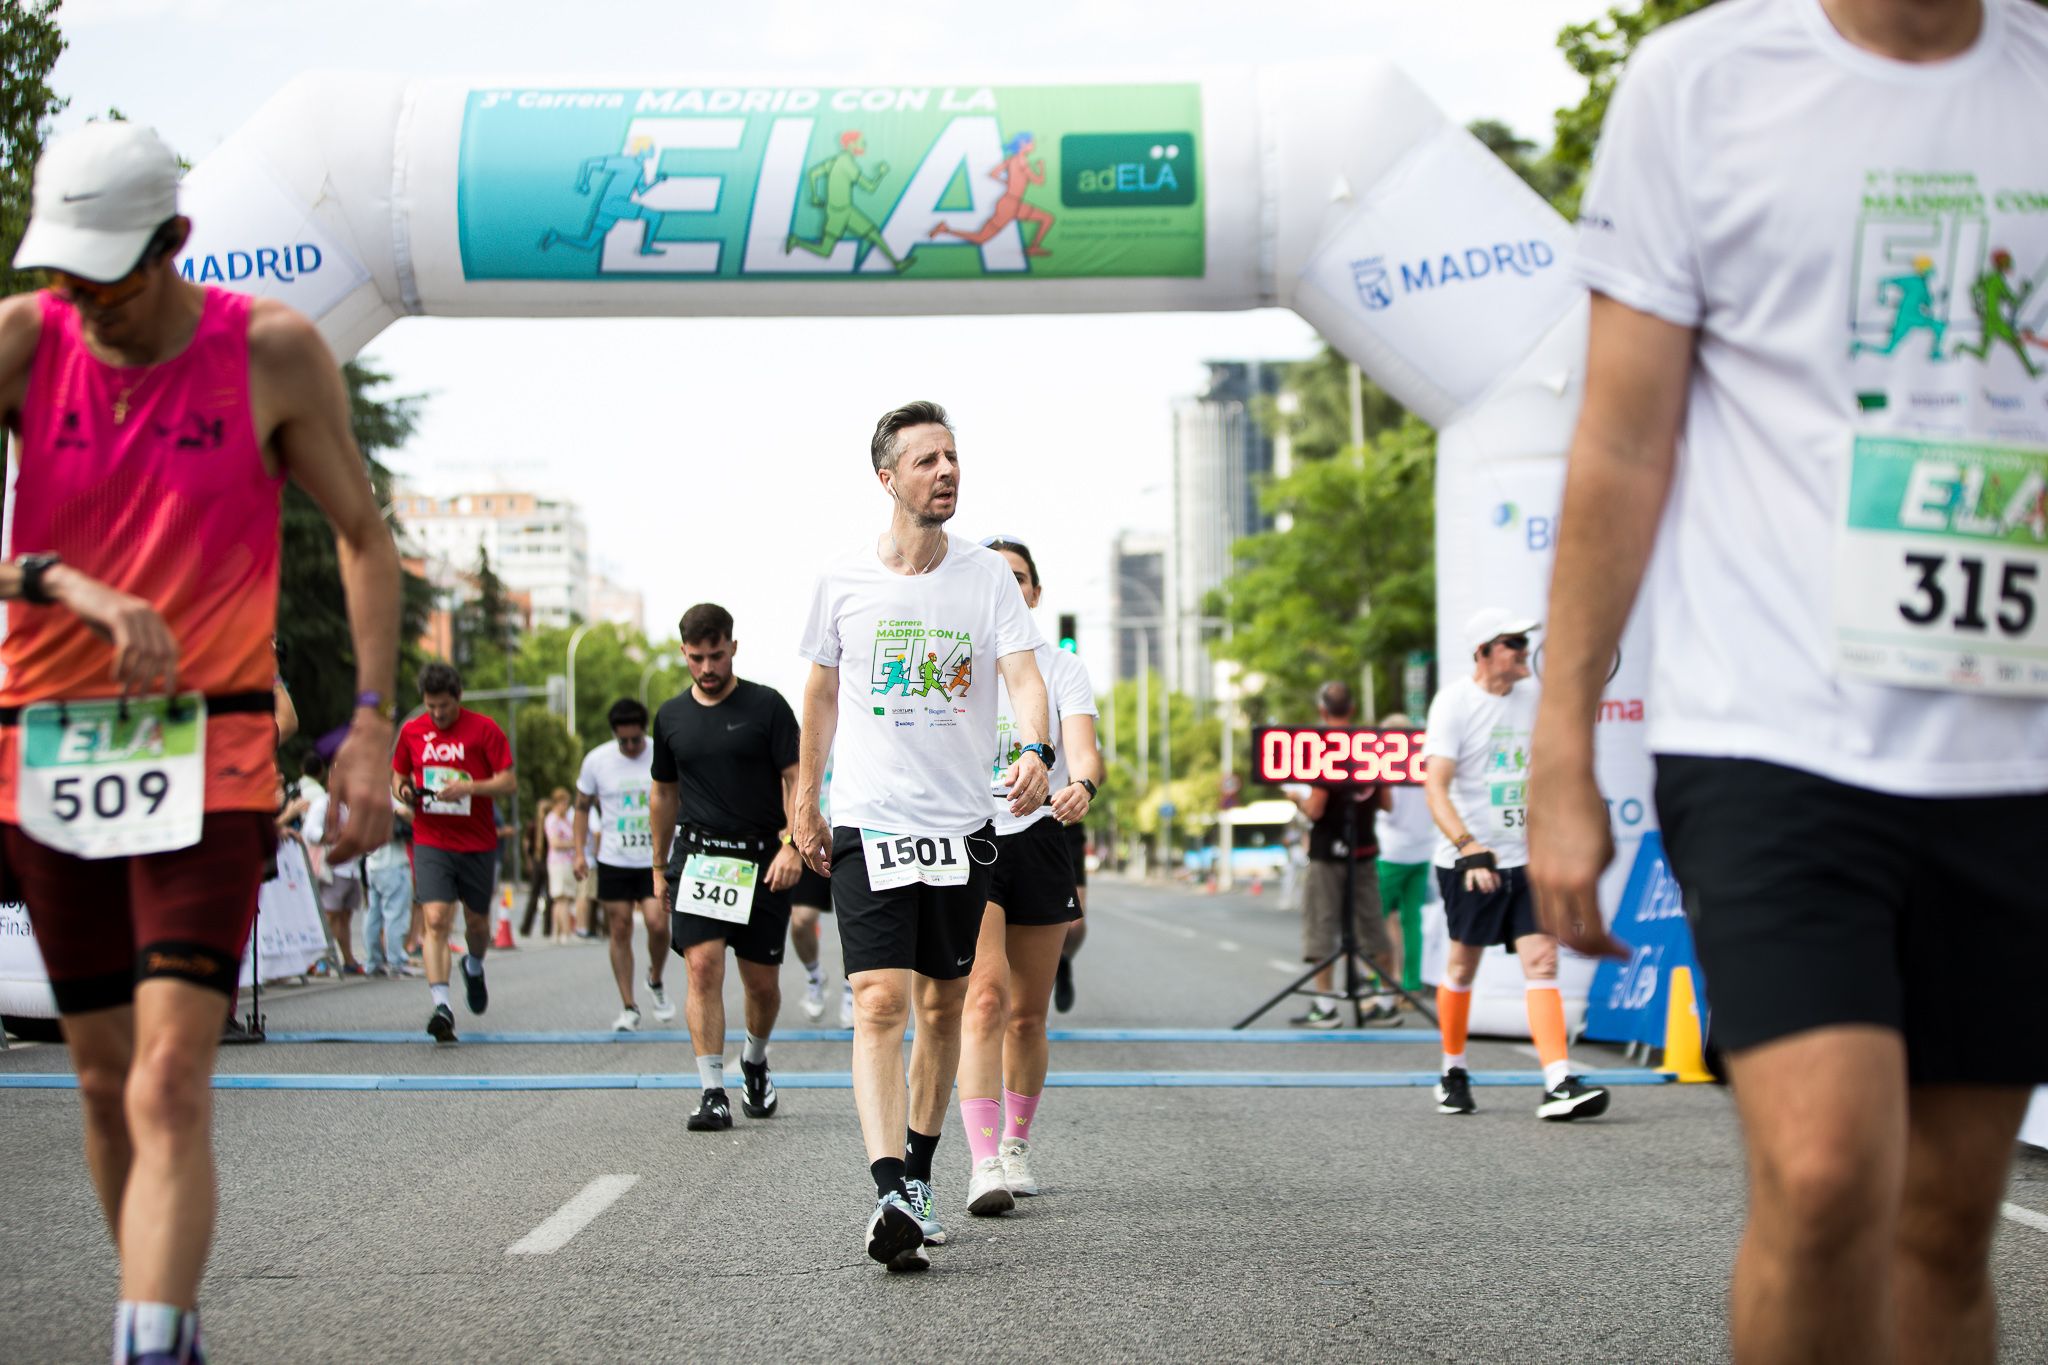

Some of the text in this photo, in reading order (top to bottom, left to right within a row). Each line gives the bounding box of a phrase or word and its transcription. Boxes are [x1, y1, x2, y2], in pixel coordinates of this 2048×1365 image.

[517, 90, 625, 109] Carrera
[635, 88, 821, 113] MADRID
[830, 88, 931, 112] CON
[938, 87, 998, 111] LA
[1077, 162, 1179, 193] adELA
[599, 115, 1032, 275] ELA
[1399, 239, 1555, 294] MADRID
[1899, 552, 2038, 637] 315
[876, 628, 971, 641] MADRID CON LA
[888, 619, 923, 627] Carrera
[871, 638, 973, 685] ELA
[421, 741, 465, 763] AON
[54, 770, 170, 823] 509
[876, 836, 957, 870] 1501
[692, 881, 738, 907] 340
